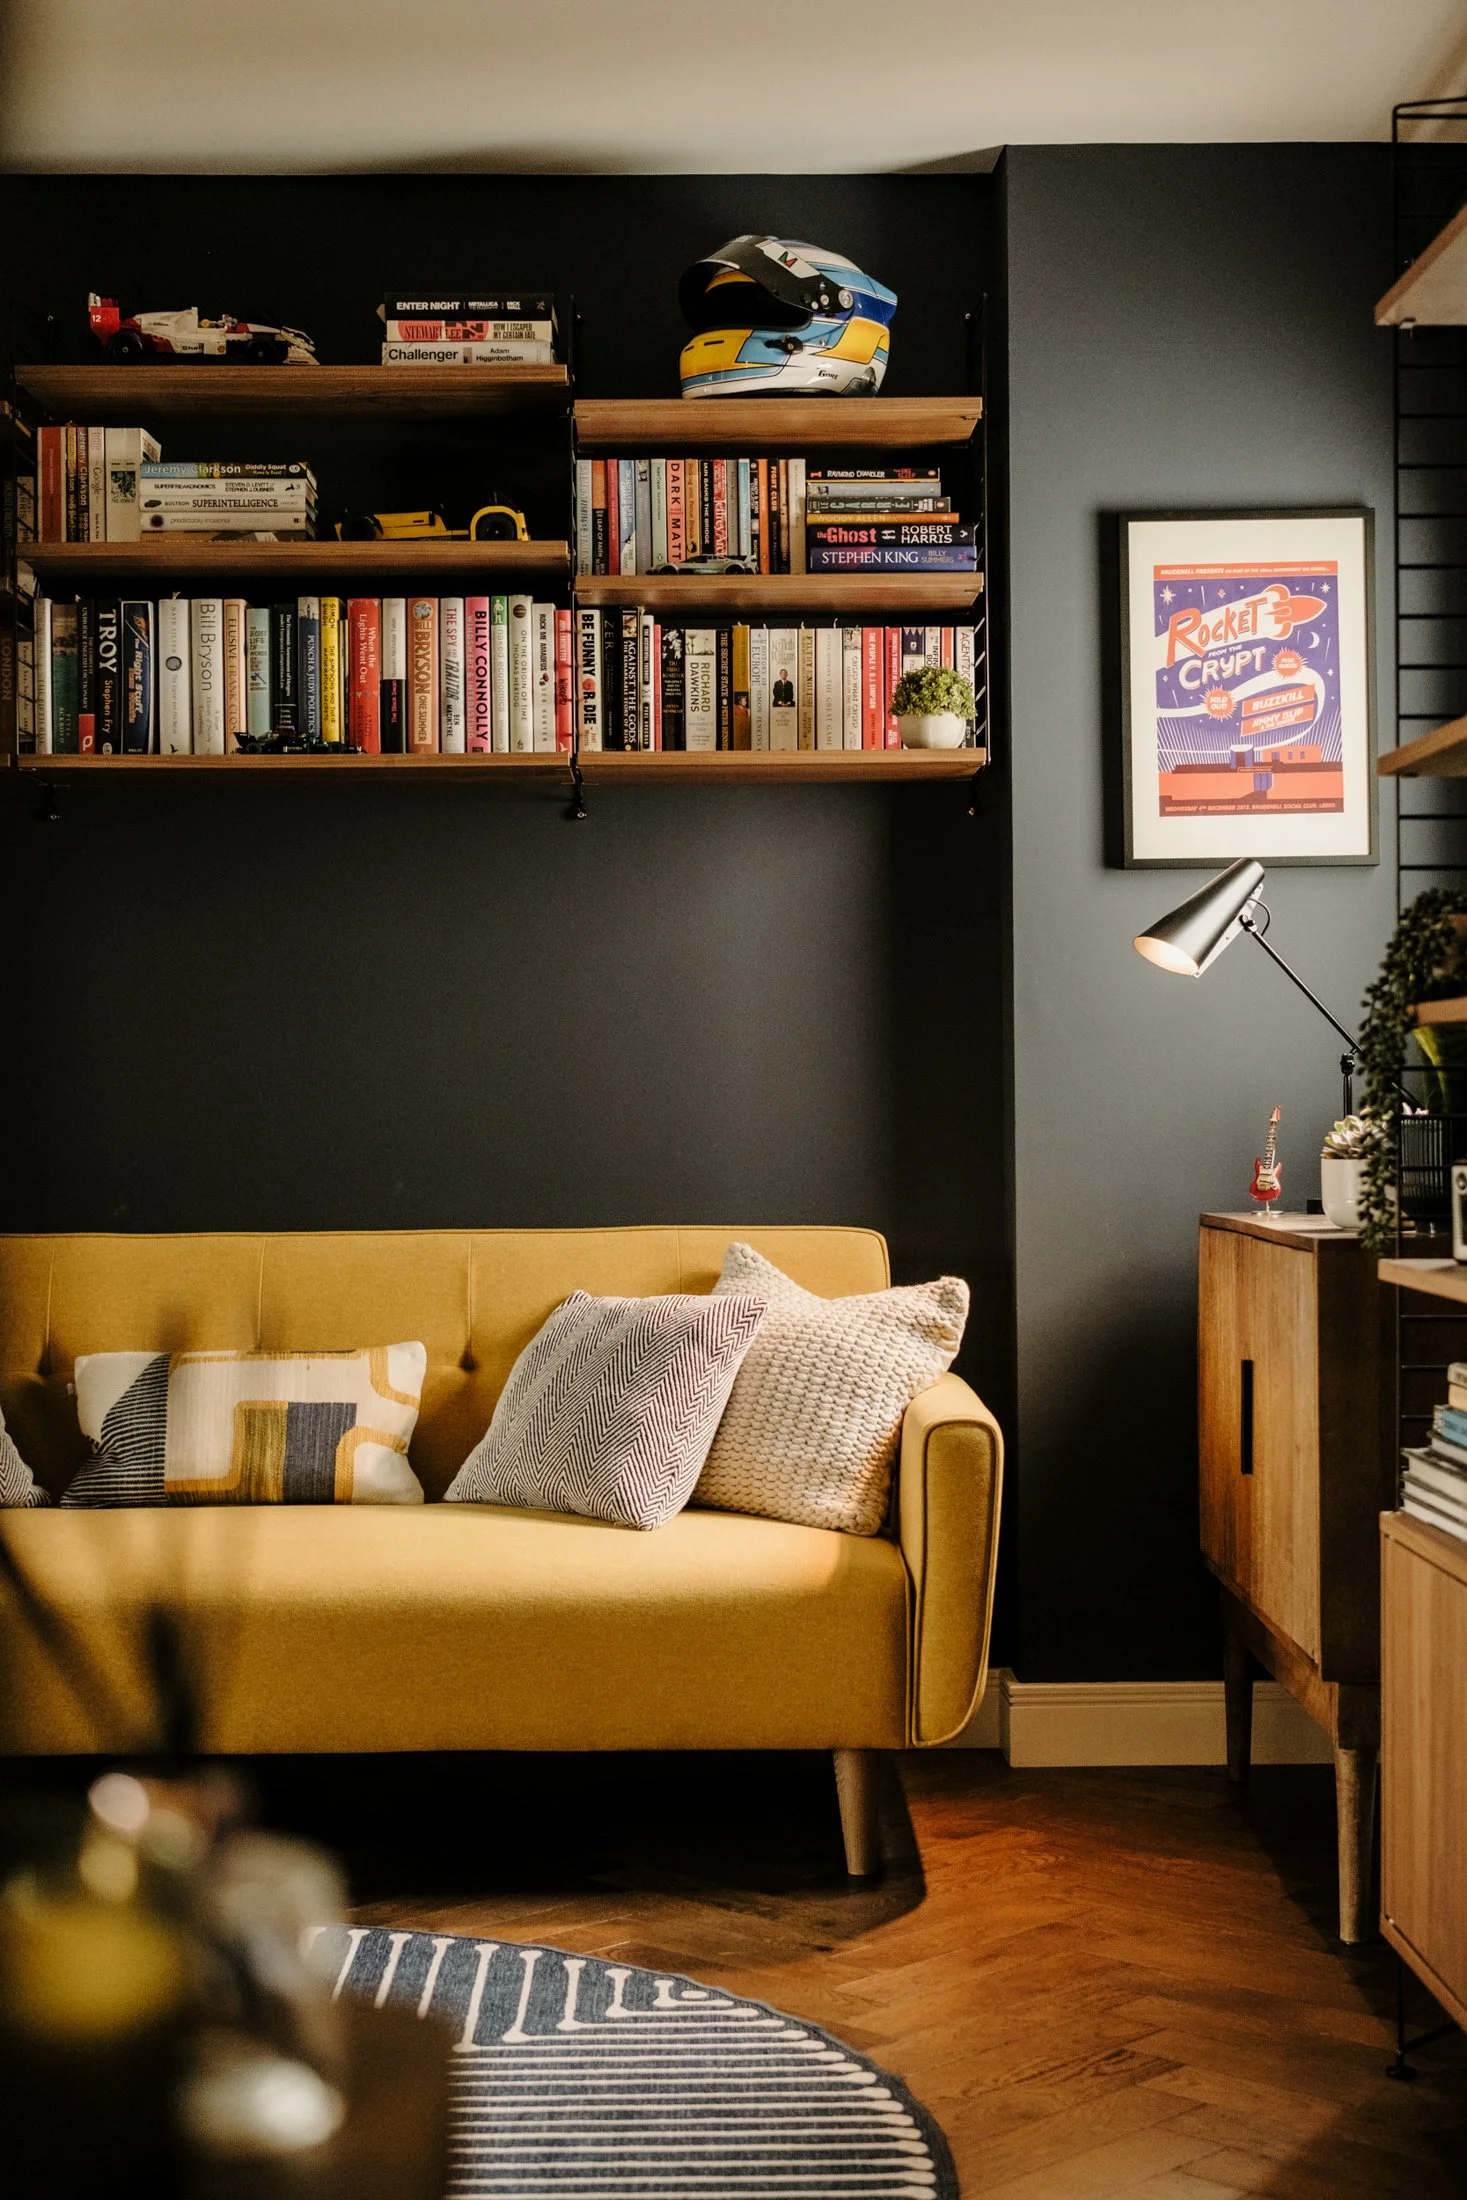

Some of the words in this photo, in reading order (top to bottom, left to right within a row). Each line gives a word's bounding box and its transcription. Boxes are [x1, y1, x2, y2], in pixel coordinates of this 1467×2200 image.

[91, 314, 101, 322] 12
[396, 301, 429, 311] ENTER
[430, 301, 460, 311] NIGHT
[405, 325, 442, 340] STEWART
[446, 328, 461, 339] LEE
[388, 348, 459, 362] Challenger
[78, 431, 89, 463] Jeremy
[144, 463, 187, 476] Jeremy
[190, 463, 241, 475] Clarkson
[245, 464, 267, 472] Diddly
[267, 464, 286, 472] Squat
[80, 467, 88, 506] Clarkson
[91, 467, 103, 495] Google
[671, 463, 681, 505] DARK
[192, 499, 278, 508] SUPERINTELLIGENCE
[713, 500, 727, 533] Jeffrey
[671, 518, 682, 561] MATT
[826, 527, 877, 544] Ghost
[901, 525, 952, 534] ROBERT
[901, 534, 952, 543] HARRIS
[821, 552, 881, 564] STEPHEN
[885, 552, 919, 564] KING
[200, 604, 216, 628] Bill
[358, 613, 367, 640] Lights
[415, 621, 431, 630] BILL
[446, 608, 457, 625] THE
[582, 613, 594, 629] BE
[98, 609, 117, 673] TROY
[228, 618, 238, 661] ELUSIVE
[368, 627, 376, 652] When
[446, 628, 457, 647] SPY
[475, 611, 487, 651] BILLY
[521, 630, 527, 642] ON
[540, 631, 547, 640] ME
[720, 633, 728, 646] THE
[1167, 597, 1268, 668] ROCKET
[359, 643, 367, 665] Went
[497, 629, 505, 658] naked
[582, 633, 595, 677] FUNNY
[961, 633, 970, 662] AGENT
[1208, 648, 1227, 658] FROM
[1228, 644, 1242, 654] THE
[133, 650, 143, 682] Right
[198, 633, 216, 691] Bryson
[368, 655, 376, 668] the
[415, 631, 431, 694] BRYSON
[628, 640, 636, 688] AGAINST
[720, 648, 728, 675] SECRET
[752, 646, 760, 686] EUROPE
[1178, 646, 1267, 690] CRYPT
[228, 665, 238, 700] FRANK
[307, 672, 315, 693] JUDY
[359, 666, 367, 683] Out
[445, 659, 460, 701] TRAITOR
[720, 676, 728, 697] STATE
[102, 679, 114, 716] Stephen
[135, 683, 143, 714] Stuff
[476, 655, 488, 741] CONNOLLY
[521, 691, 527, 701] OF
[690, 662, 700, 712] DAWKINS
[701, 662, 710, 713] RICHARD
[419, 695, 427, 709] ONE
[628, 689, 636, 711] THE
[1252, 690, 1304, 711] BUZZKILL
[102, 719, 113, 734] Fry
[418, 711, 428, 742] SUMMER
[628, 713, 636, 743] GODS
[1252, 712, 1280, 728] JIMMY
[1282, 708, 1304, 720] ISLIP
